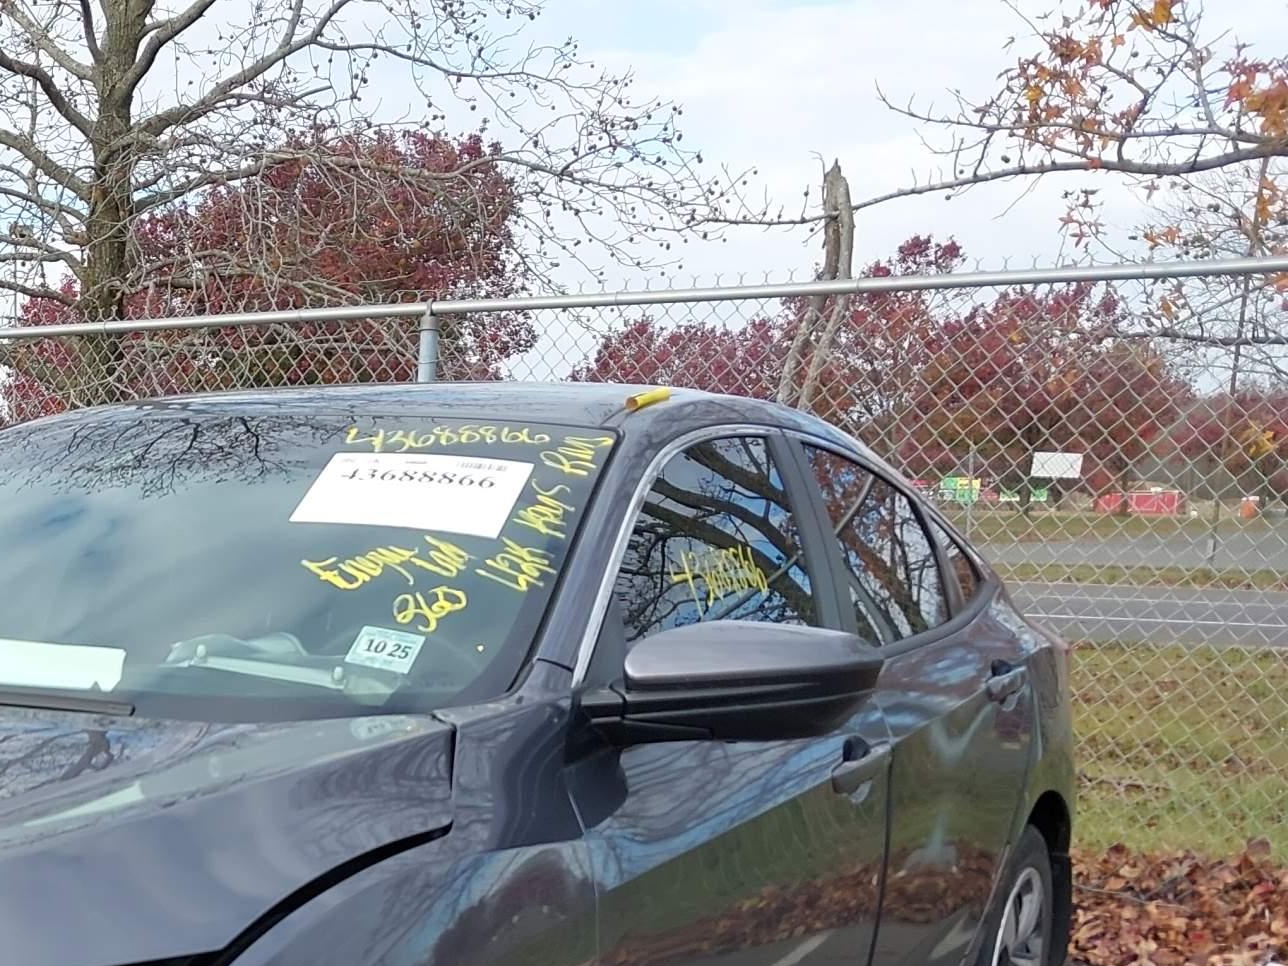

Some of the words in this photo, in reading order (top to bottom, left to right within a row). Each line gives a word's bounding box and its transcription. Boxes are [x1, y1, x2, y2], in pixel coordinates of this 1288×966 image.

[346, 425, 550, 452] 43688866
[341, 468, 495, 488] 43688866
[363, 639, 387, 653] 10
[387, 643, 412, 659] 25
